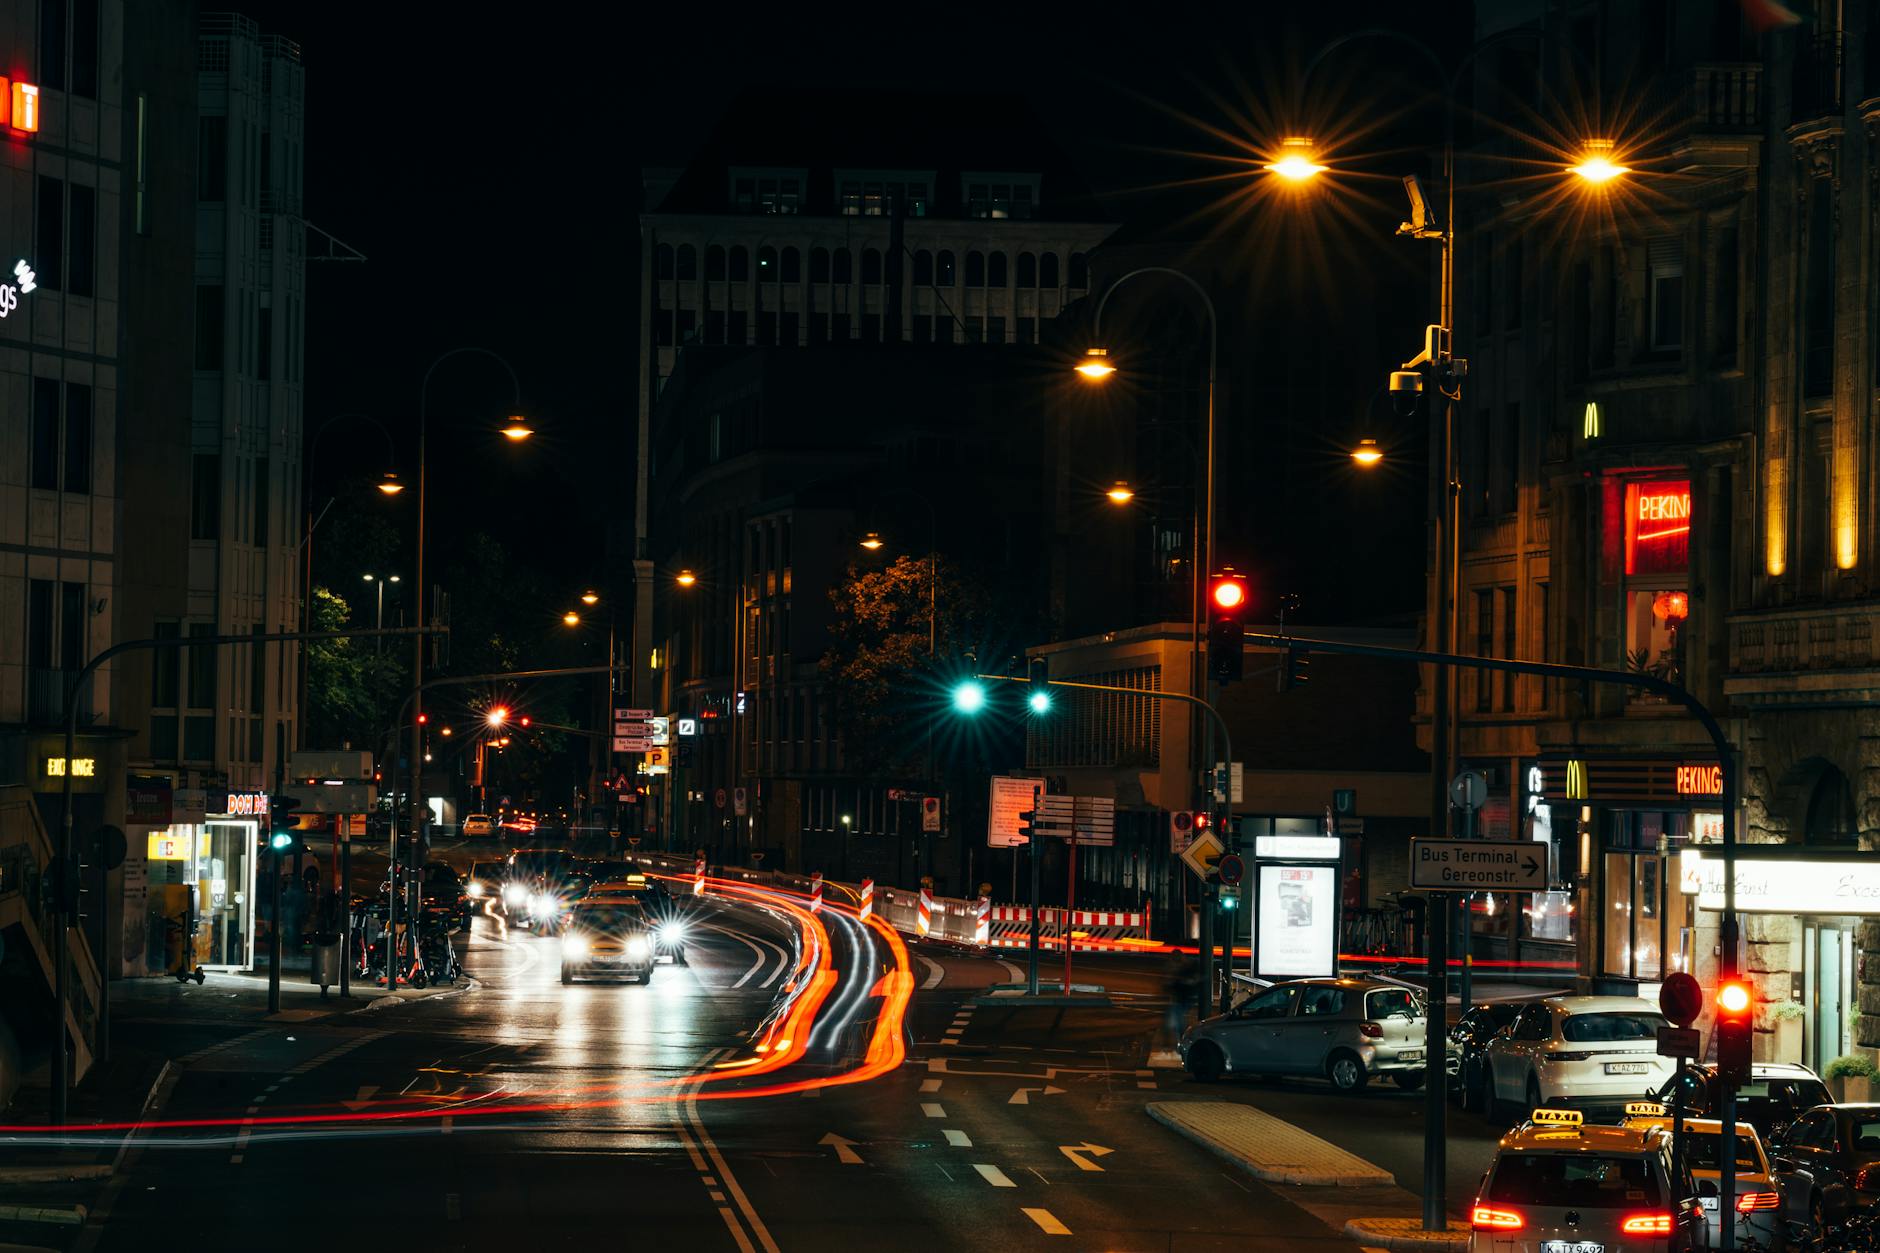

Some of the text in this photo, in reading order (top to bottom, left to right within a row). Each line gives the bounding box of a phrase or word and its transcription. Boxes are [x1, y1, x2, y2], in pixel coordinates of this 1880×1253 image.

[1640, 494, 1690, 520] PEKIN
[1677, 766, 1721, 794] PEKING
[227, 794, 253, 815] DOM
[1421, 847, 1518, 864] Bus Terminal
[1442, 867, 1518, 883] Gereonstr.
[1541, 1112, 1574, 1121] TAXI
[1634, 1104, 1657, 1112] TAXI
